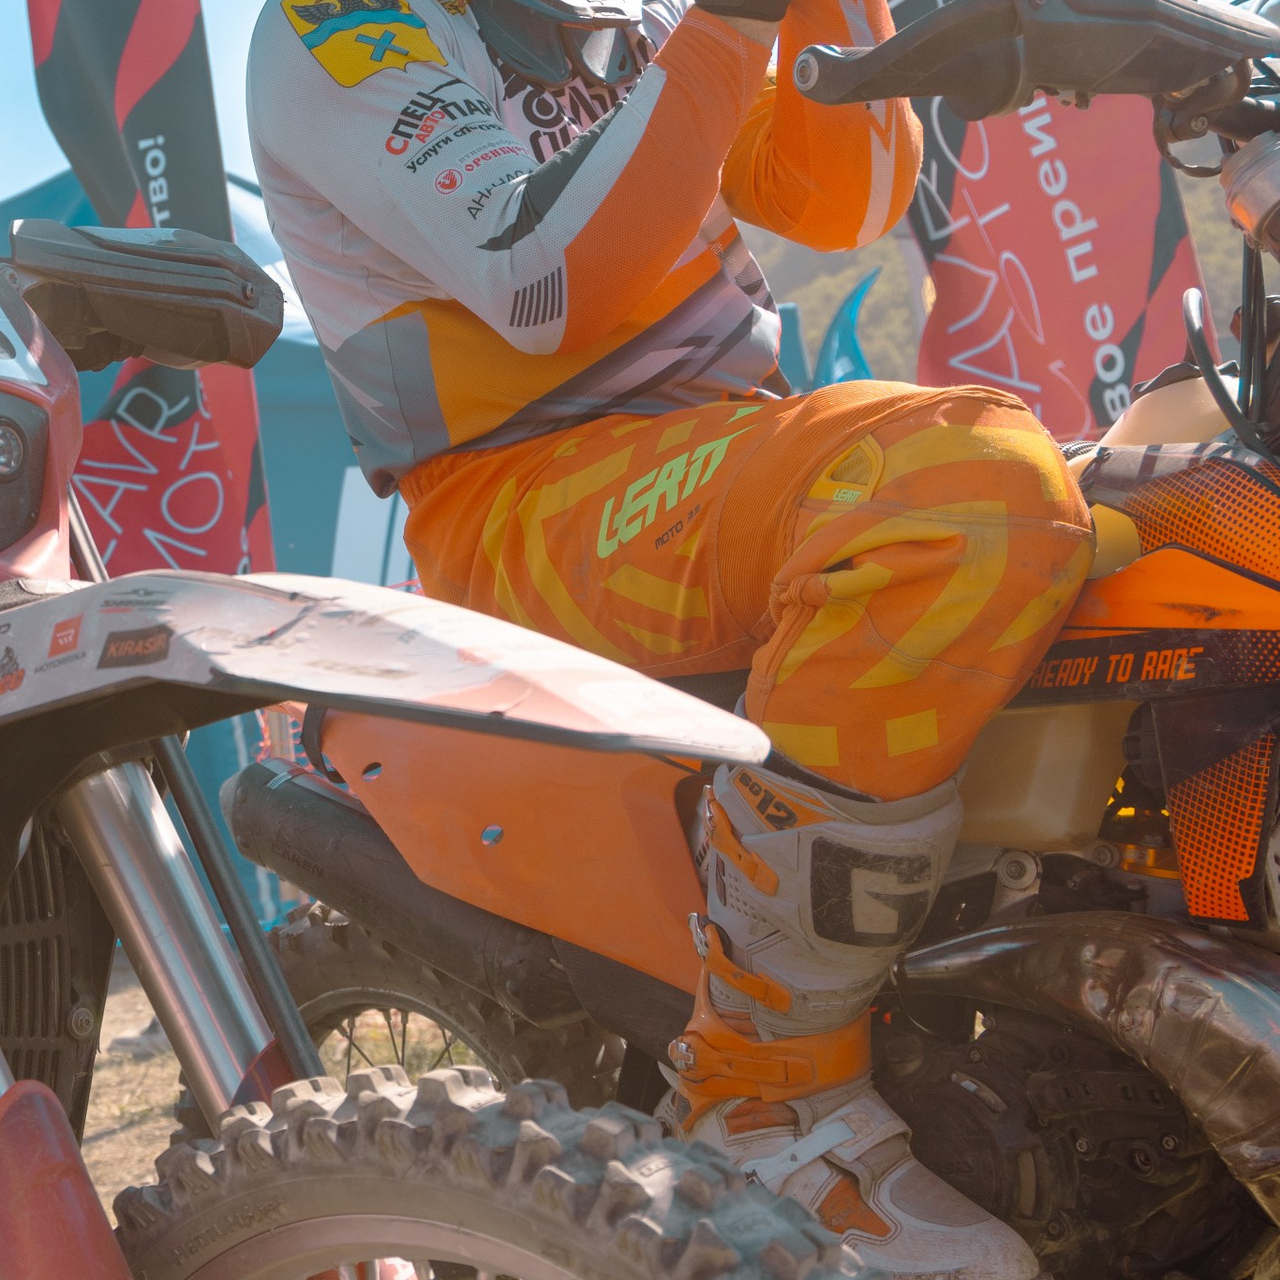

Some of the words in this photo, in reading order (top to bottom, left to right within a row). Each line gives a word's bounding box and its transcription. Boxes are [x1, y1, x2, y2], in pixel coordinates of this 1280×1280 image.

[438, 97, 494, 122] ПАР
[414, 110, 447, 145] АВТО
[596, 422, 761, 560] LEATT
[832, 487, 862, 503] LEATT
[654, 521, 685, 551] MOTO
[1030, 655, 1100, 688] READY
[1105, 652, 1136, 684] TO
